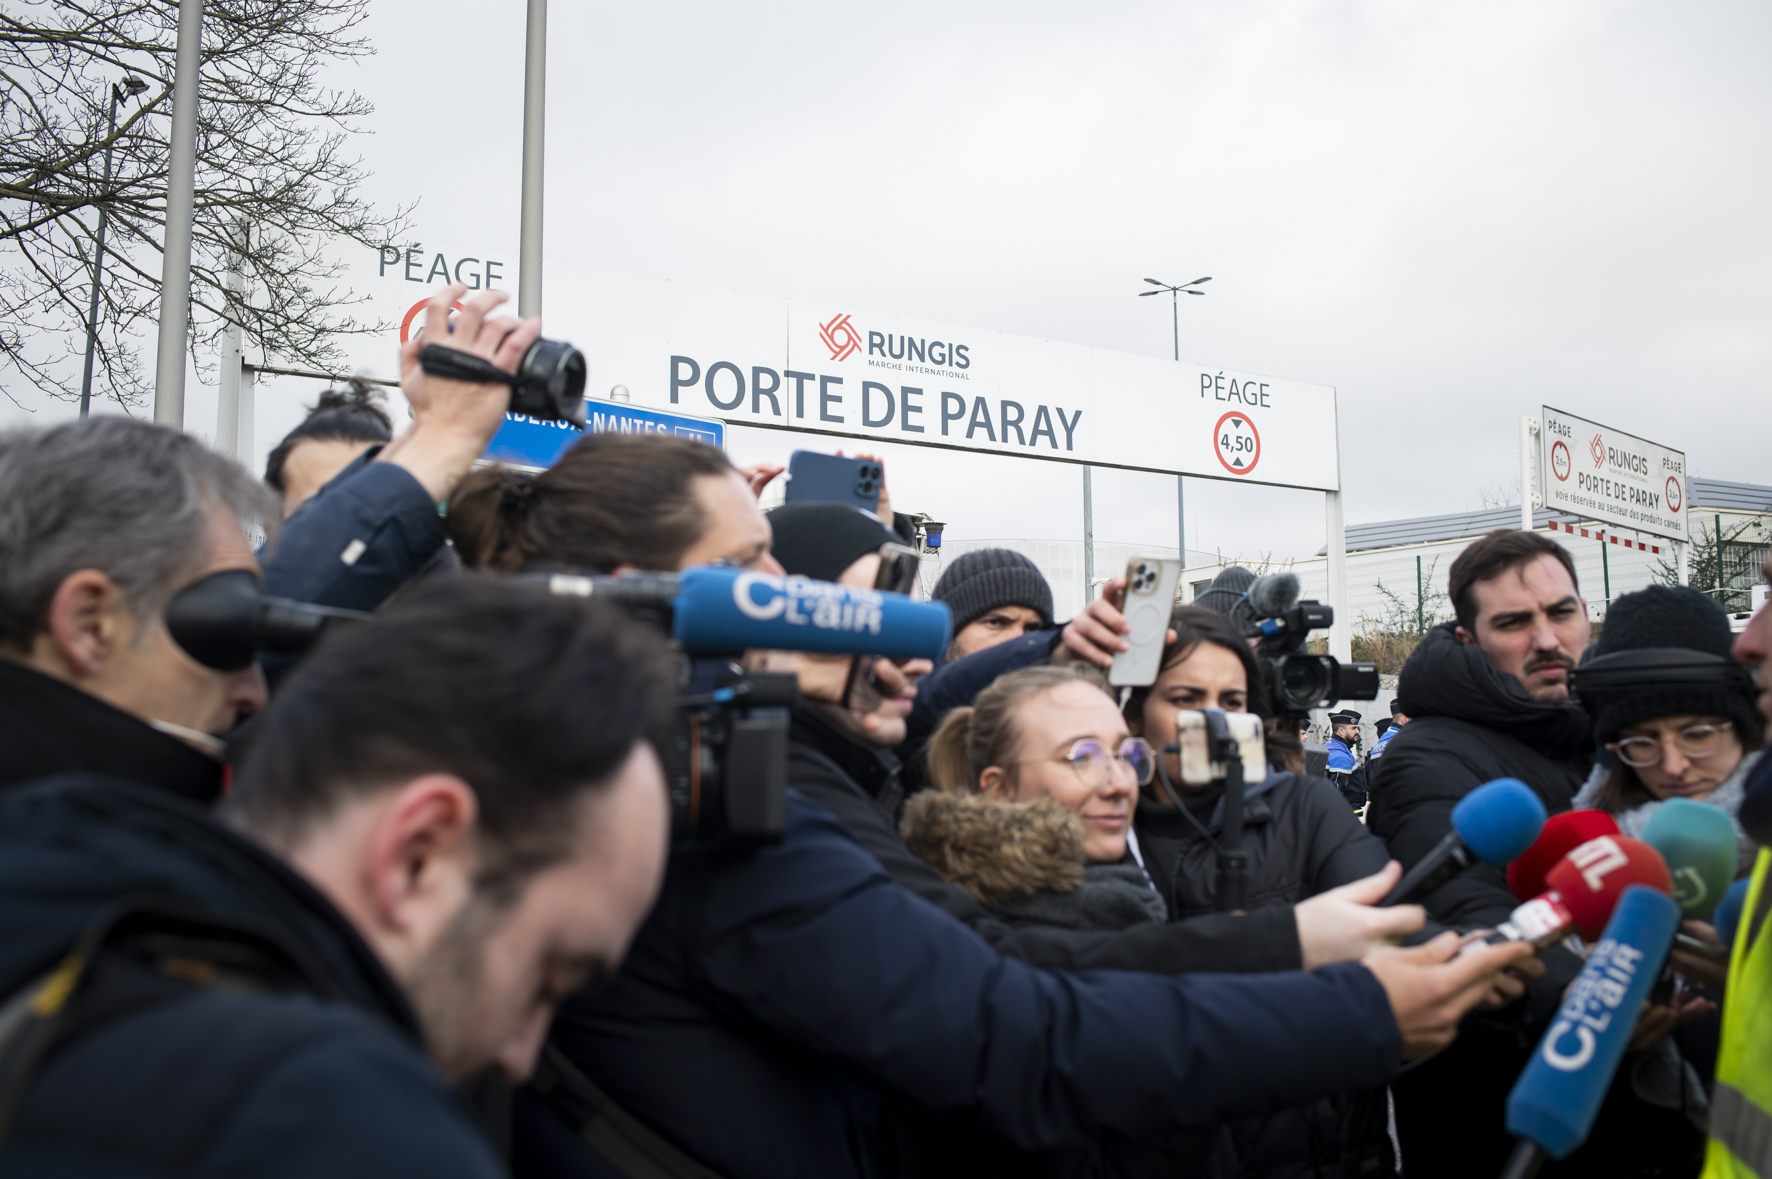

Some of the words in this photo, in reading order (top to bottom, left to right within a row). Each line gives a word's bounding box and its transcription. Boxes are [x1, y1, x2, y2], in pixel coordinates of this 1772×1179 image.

[379, 242, 504, 291] PÉAGE
[868, 330, 971, 370] RUNGIS
[868, 359, 903, 371] MARCHÉ
[905, 364, 971, 381] INTERNATIONAL
[669, 354, 845, 424] PORTE
[861, 380, 926, 434] DE
[940, 391, 1083, 451] PARAY
[1200, 371, 1271, 408] PÉAGE
[1220, 433, 1253, 453] 4,50
[1548, 419, 1572, 438] PÉAGE
[1608, 446, 1648, 476] RUNGIS
[1663, 458, 1682, 473] PÉAGE
[1578, 471, 1612, 498] PORTE
[1614, 481, 1627, 502] DE
[1629, 486, 1660, 511] PARAY
[1555, 489, 1569, 501] voie
[1570, 493, 1596, 509] réservée
[1597, 502, 1605, 511] au
[1606, 505, 1628, 517] secteur
[1629, 507, 1639, 520] des
[1640, 512, 1663, 525] produits
[1663, 519, 1682, 531] carnés
